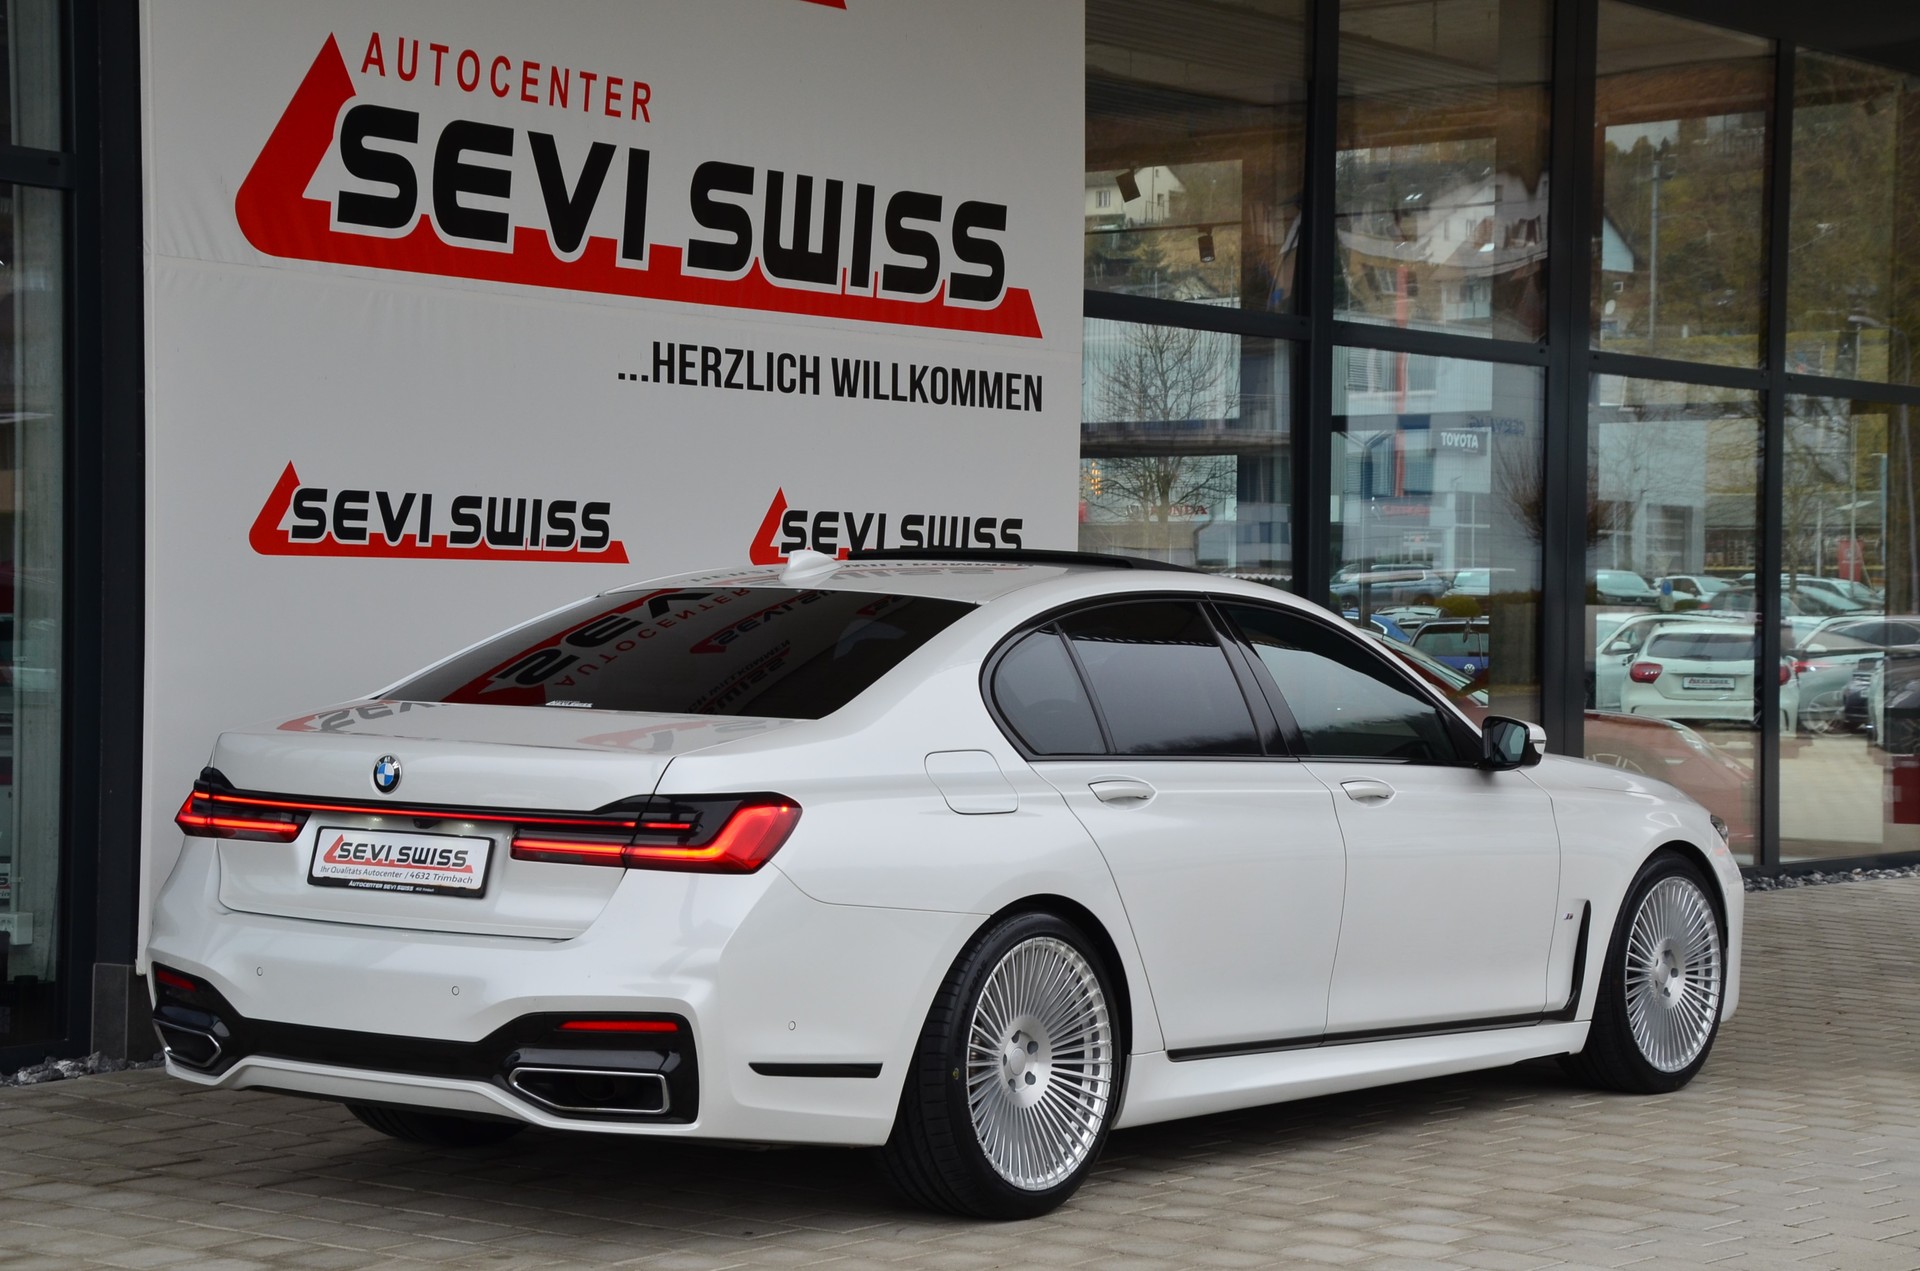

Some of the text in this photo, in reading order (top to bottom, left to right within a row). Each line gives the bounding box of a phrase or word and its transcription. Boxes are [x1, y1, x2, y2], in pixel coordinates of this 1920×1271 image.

[361, 32, 652, 123] AUTOCENTER
[337, 104, 1008, 302] SEVI SWISS
[830, 357, 1043, 413] WILLKOMMEN
[1440, 432, 1479, 449] TOYOTA
[291, 487, 611, 549] SEVI SWISS
[780, 509, 1024, 555] SEVI SWISS
[337, 842, 469, 868] SEVI SWISS
[362, 868, 403, 879] Autocenter
[409, 871, 431, 881] 4632
[431, 873, 473, 884] Trimbach
